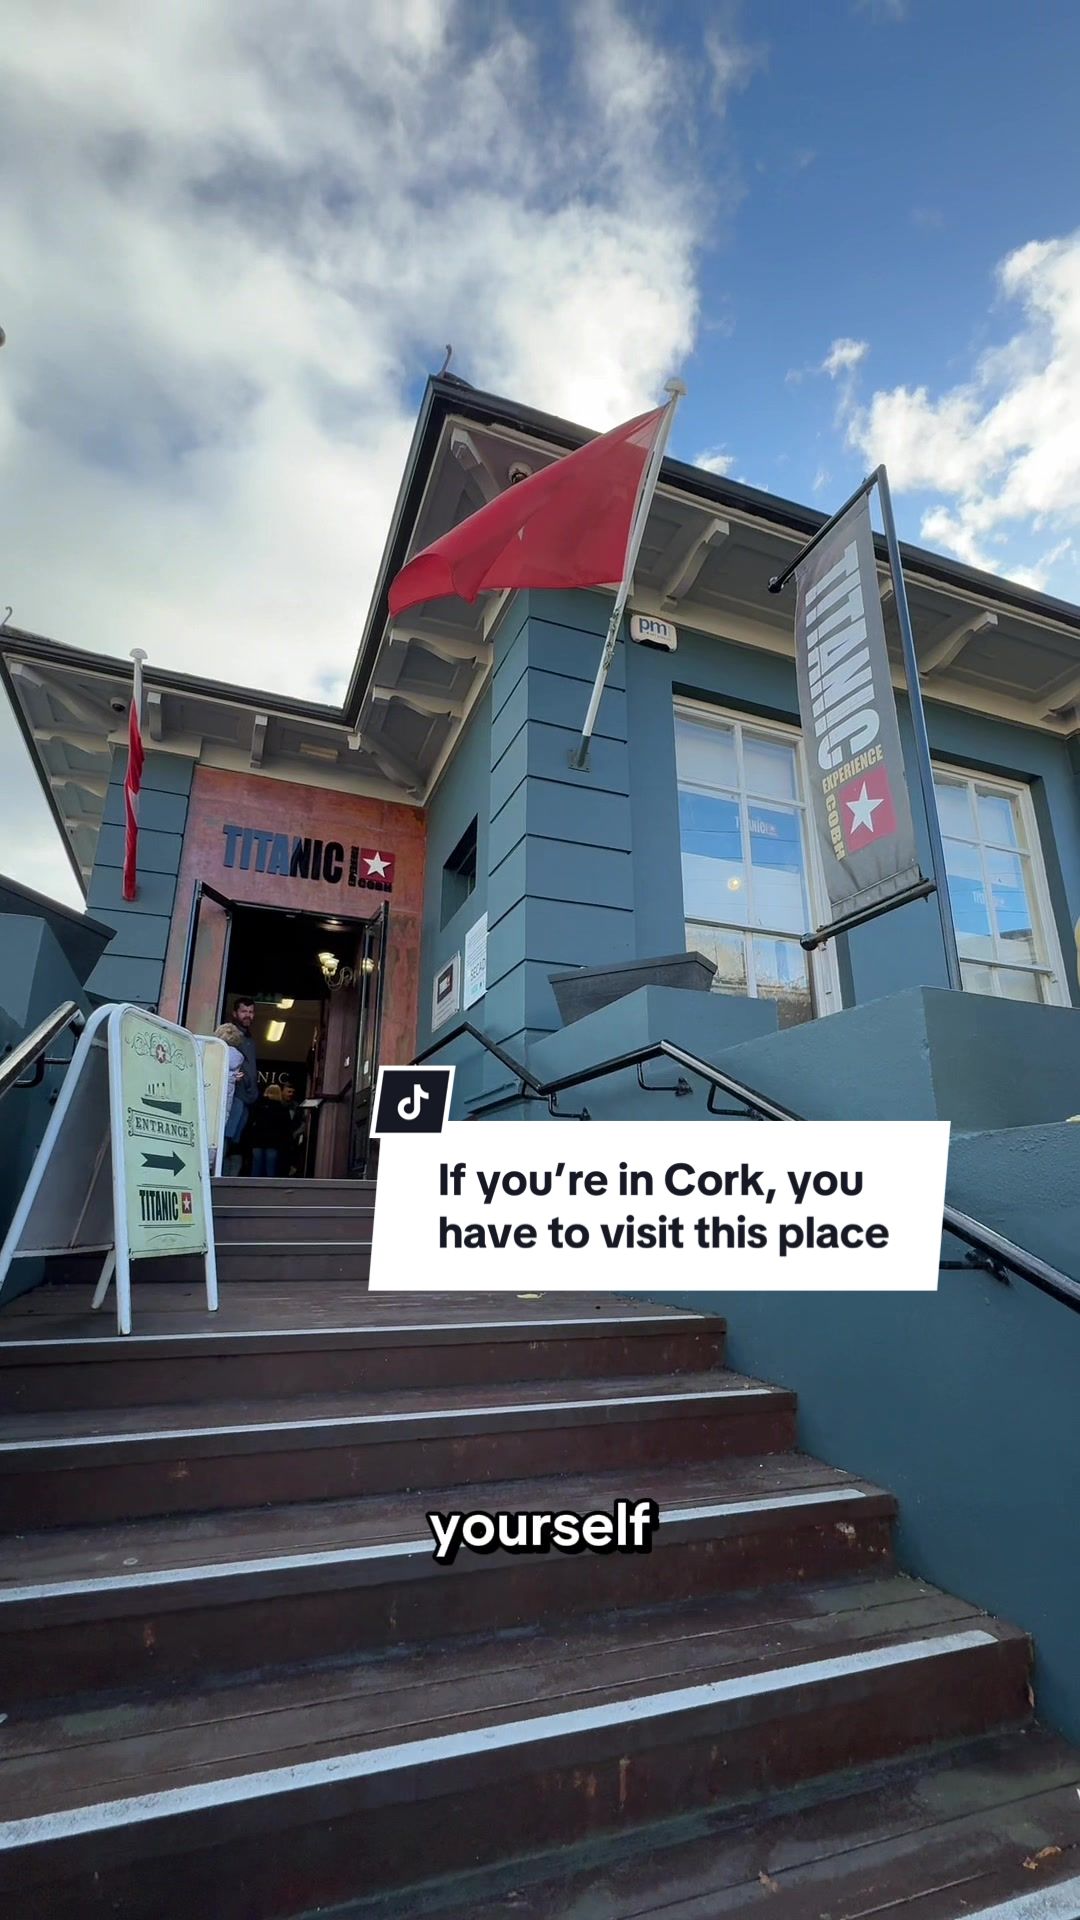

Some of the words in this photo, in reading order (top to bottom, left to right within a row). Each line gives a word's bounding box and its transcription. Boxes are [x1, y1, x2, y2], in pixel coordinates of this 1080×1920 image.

[639, 617, 667, 636] pm
[804, 539, 880, 771] TITANIC
[821, 743, 884, 795] EXPERIENCE
[825, 792, 846, 862] COBH
[223, 824, 345, 884] TITANIC
[135, 1116, 188, 1139] ENTRANCE
[138, 1189, 179, 1222] TITANIC
